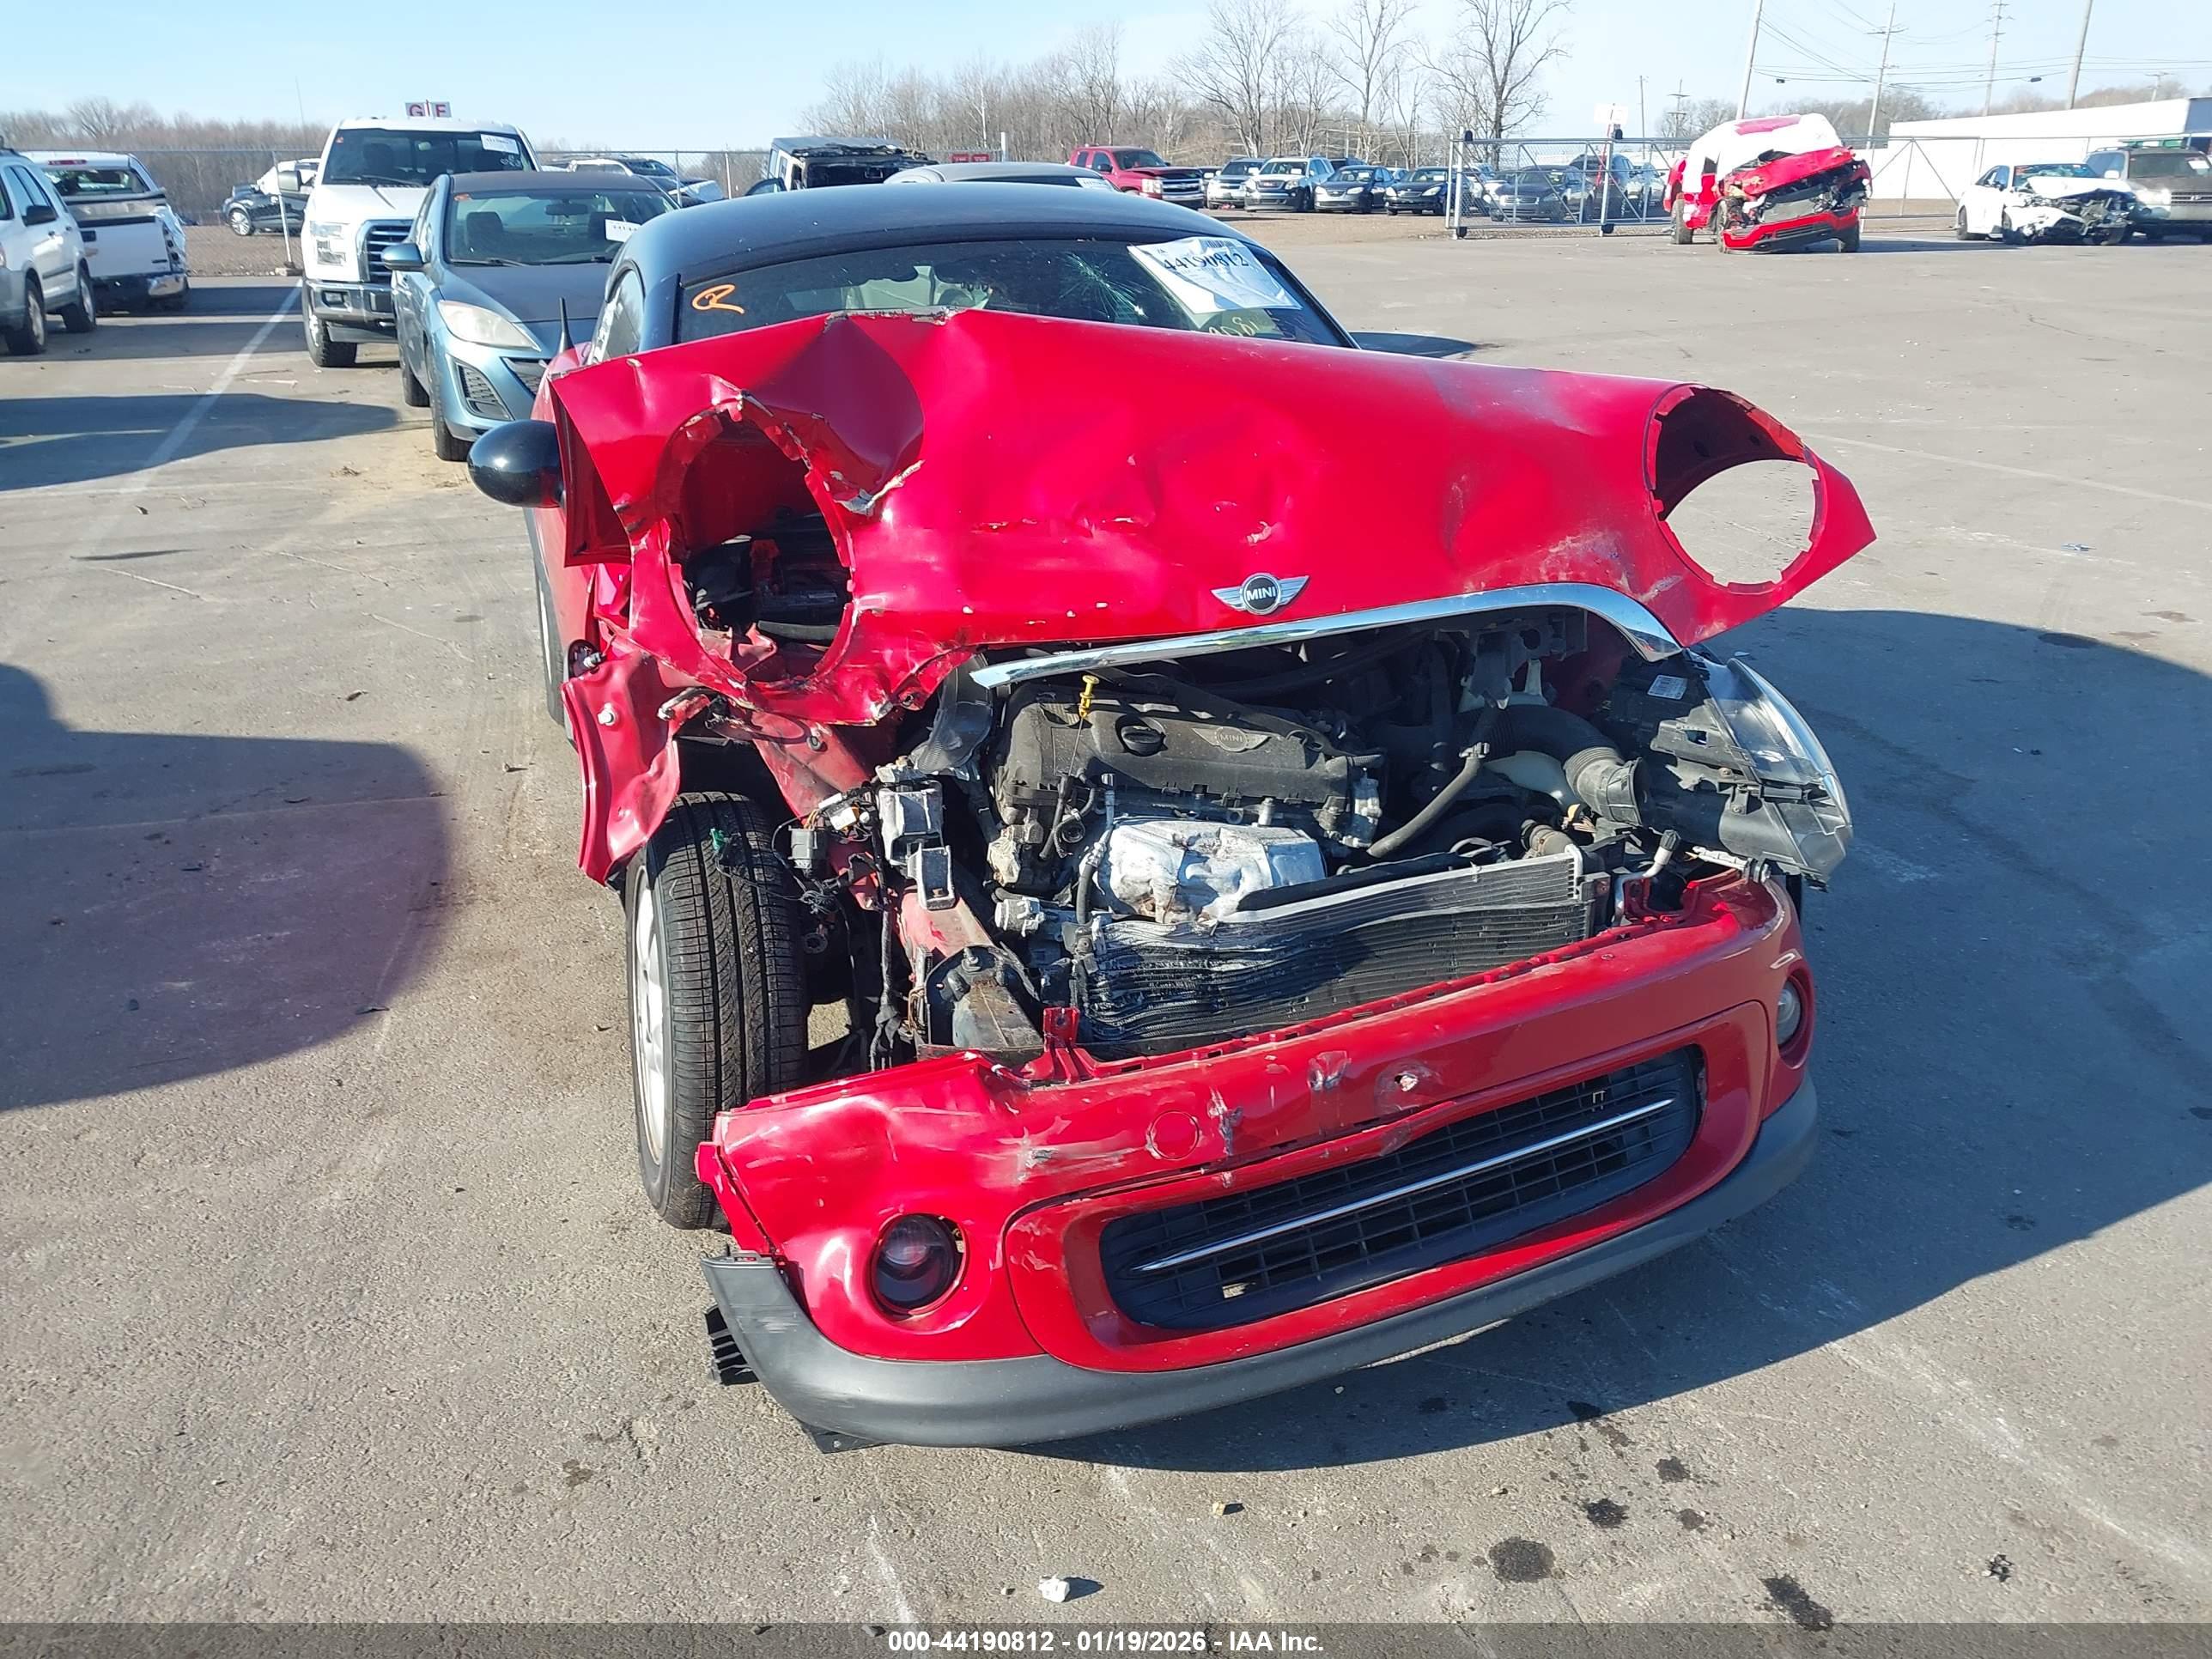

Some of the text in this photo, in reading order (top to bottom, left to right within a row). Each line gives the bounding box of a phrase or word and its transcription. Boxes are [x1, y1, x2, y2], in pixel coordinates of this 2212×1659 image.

[409, 104, 447, 117] G F
[1164, 252, 1249, 271] 44190812
[1246, 586, 1276, 601] MINI
[1220, 733, 1243, 743] MINI
